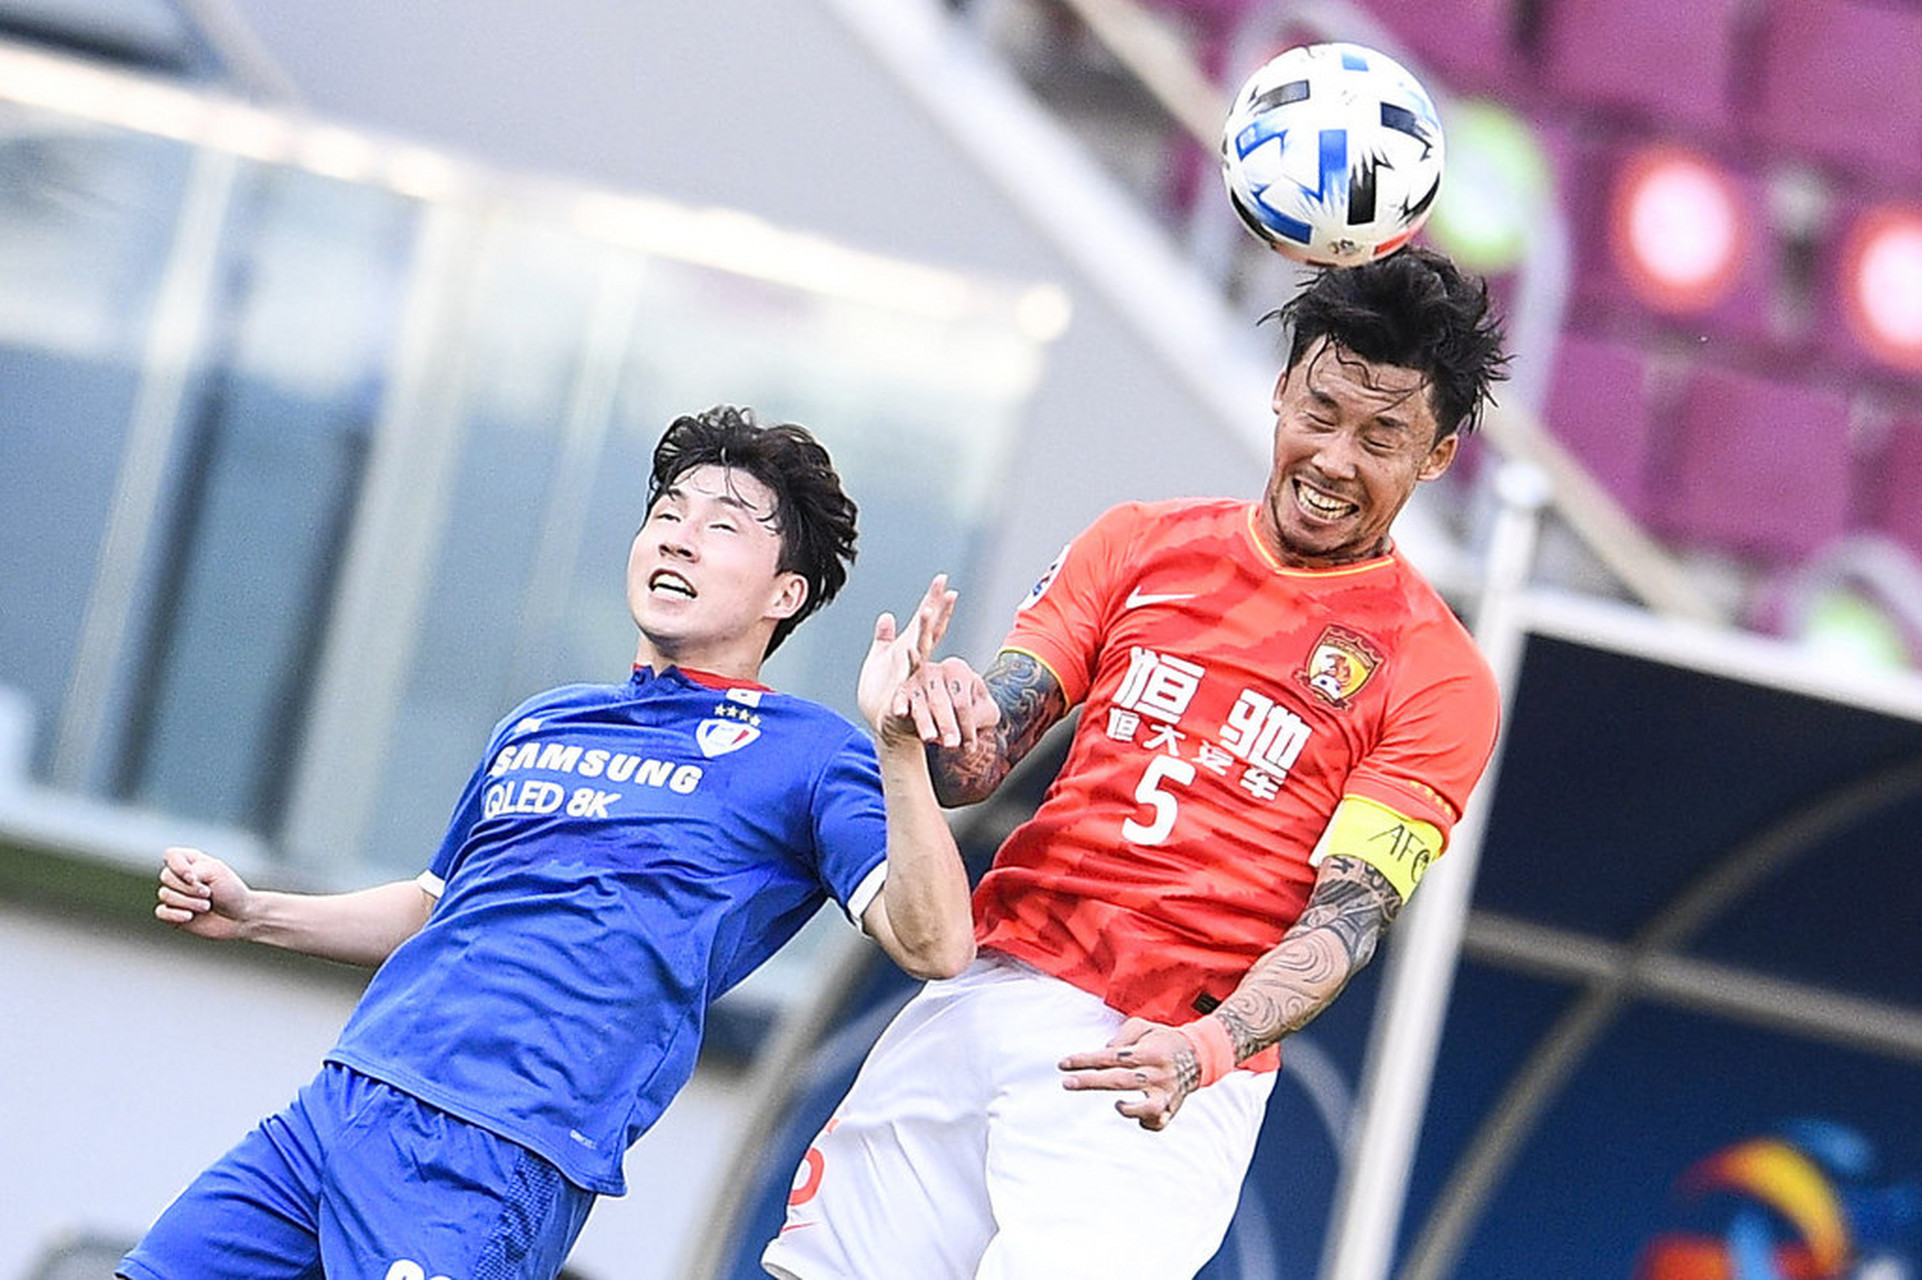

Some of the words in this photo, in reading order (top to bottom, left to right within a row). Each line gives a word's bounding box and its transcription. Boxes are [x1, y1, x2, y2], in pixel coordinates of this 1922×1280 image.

[1112, 646, 1313, 784] 恒驰
[485, 780, 565, 820] QLED
[566, 787, 622, 819] 8K
[490, 742, 703, 794] SAMSUNG
[1121, 755, 1196, 846] 5
